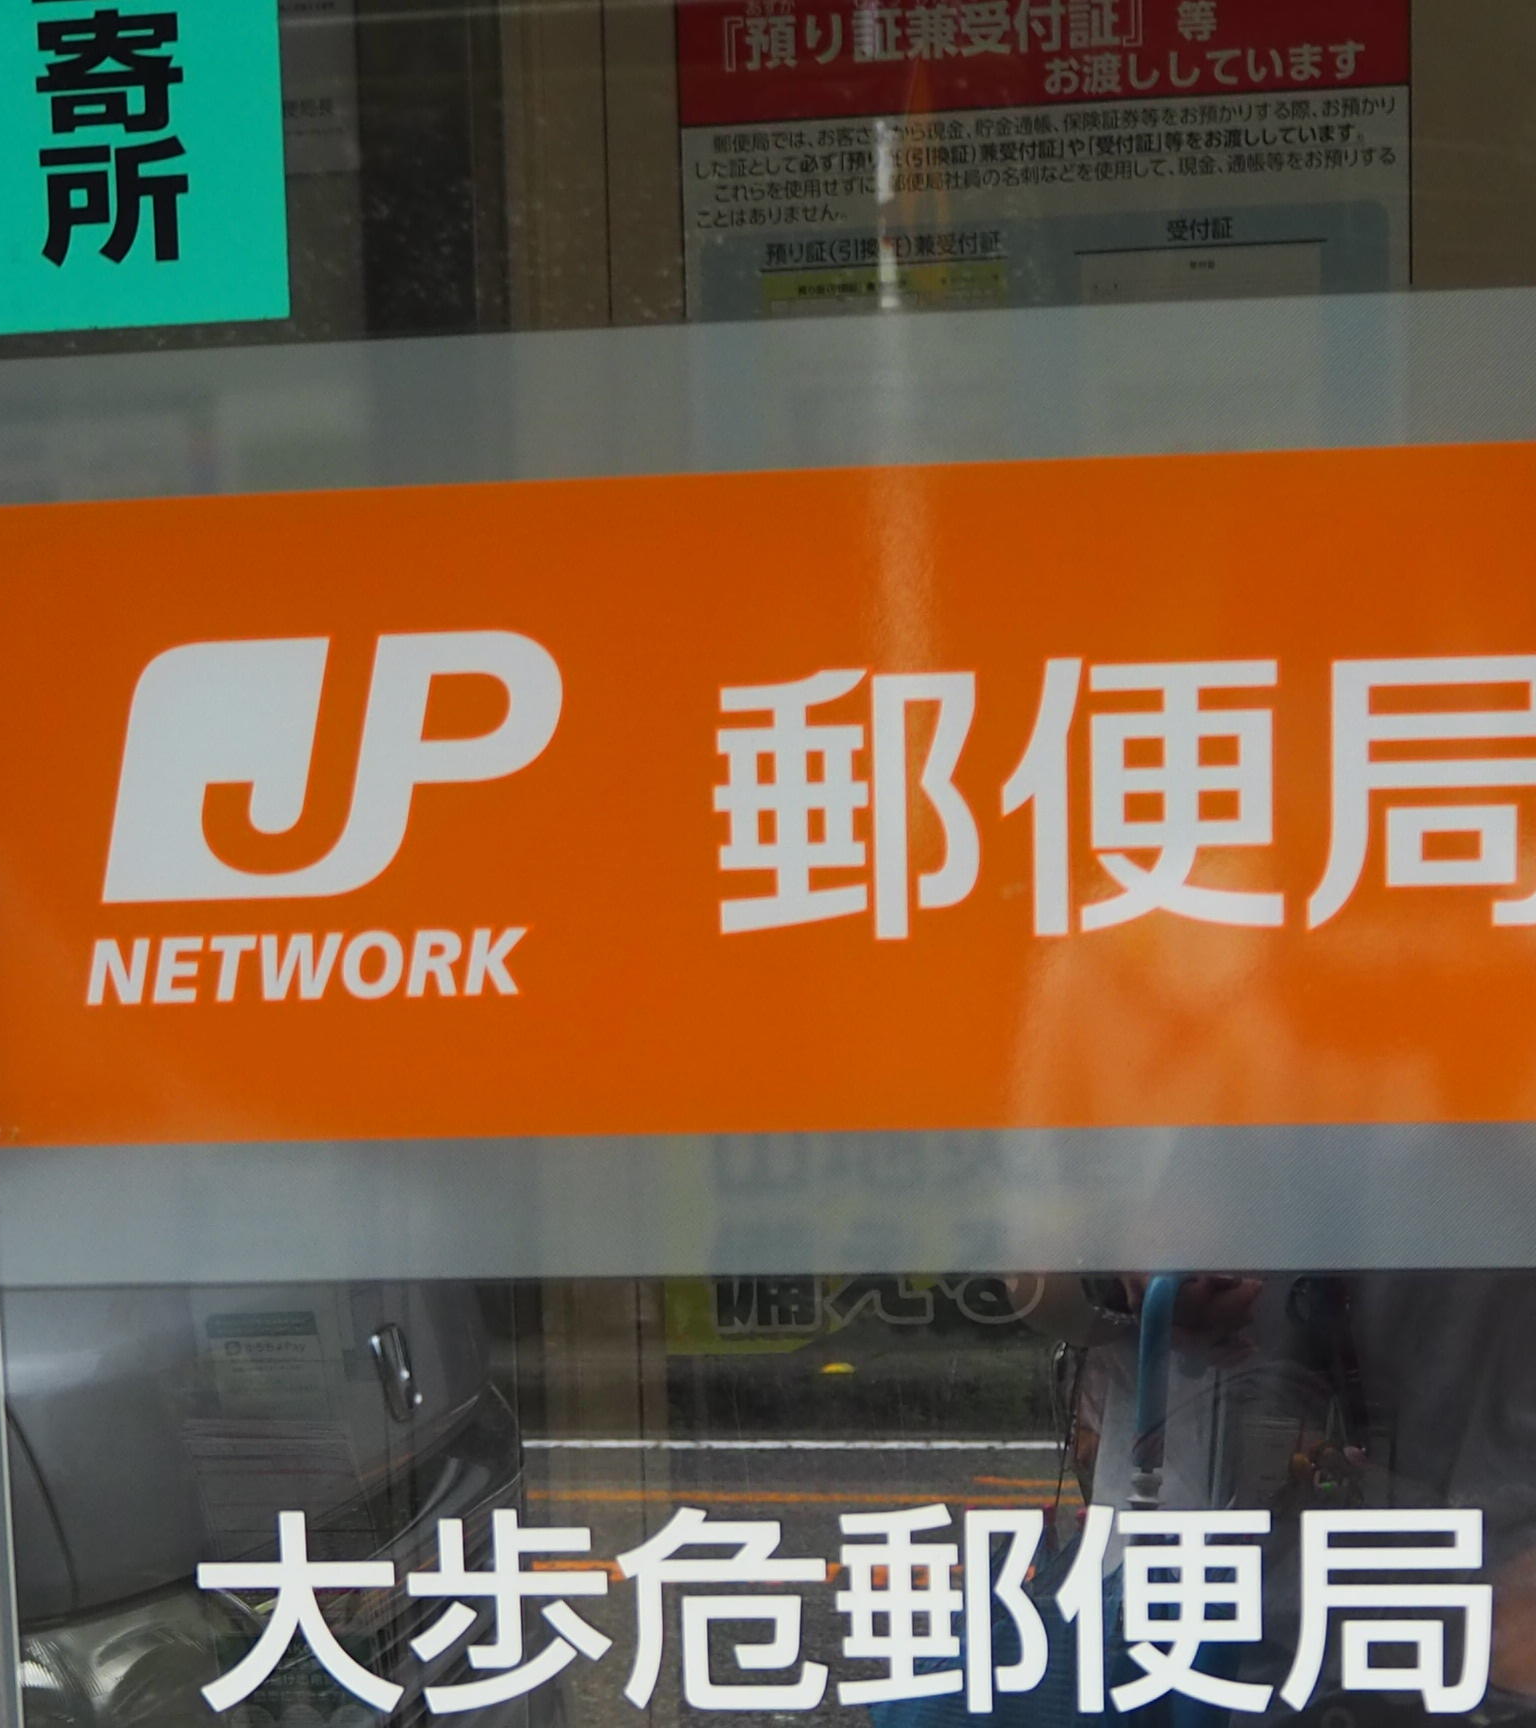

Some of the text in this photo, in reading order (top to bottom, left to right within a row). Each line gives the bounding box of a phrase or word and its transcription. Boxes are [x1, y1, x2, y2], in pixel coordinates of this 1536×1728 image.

[32, 0, 189, 267] 寄所
[1044, 41, 1366, 94] お渡ししています
[1167, 217, 1234, 241] 受付証
[102, 630, 563, 903] JP
[86, 926, 528, 1006] NETWORK
[195, 1503, 1494, 1715] 大歩危郵便局
